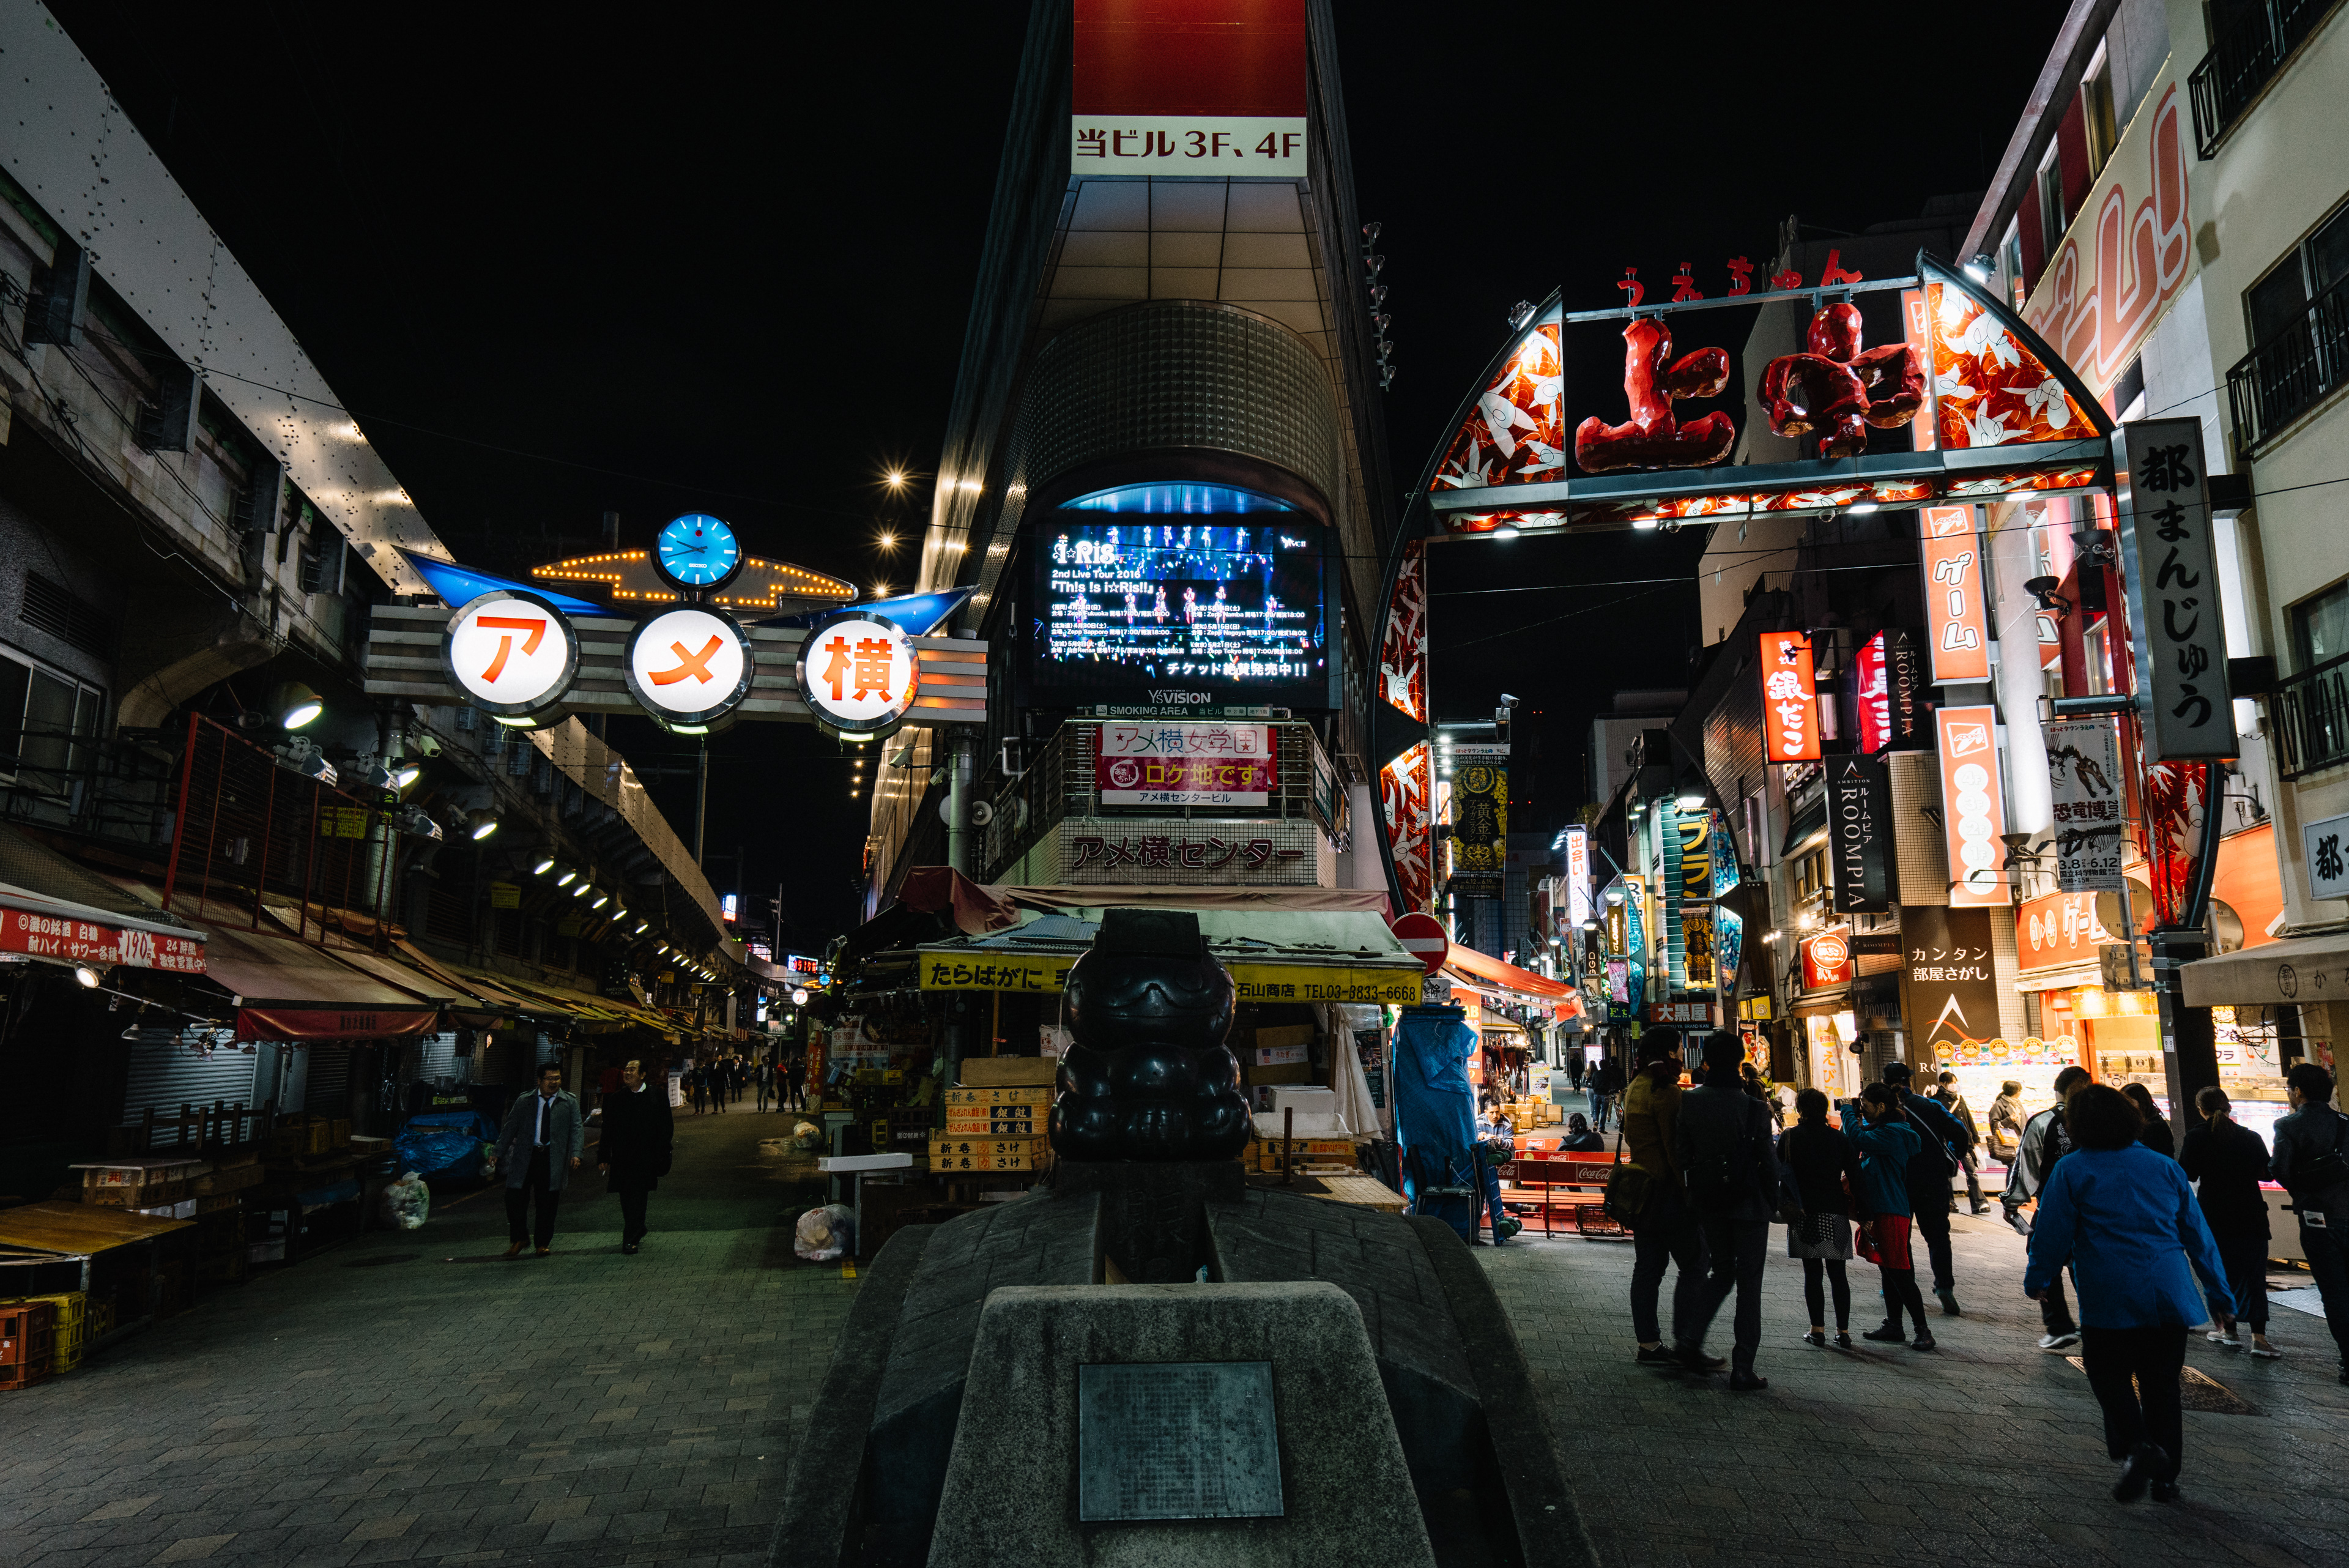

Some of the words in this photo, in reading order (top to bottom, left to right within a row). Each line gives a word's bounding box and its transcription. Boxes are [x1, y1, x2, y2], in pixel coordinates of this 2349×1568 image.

[1077, 128, 1175, 158] 当ビル
[1052, 570, 1070, 578] 2nd
[1072, 570, 1091, 578] Live
[1116, 570, 1141, 578] 2016
[2139, 444, 2211, 729] 都まんじゅう
[1934, 551, 1980, 652] ゲーム
[1163, 693, 1211, 704] VISION
[1896, 651, 1914, 735] ROOMPIA
[1110, 706, 1157, 716] SMOKING
[1160, 706, 1189, 715] AREA
[1766, 671, 1814, 756] 銀だこ
[1115, 727, 1258, 754] アメ横女学園
[1146, 763, 1258, 786] ロケ地です
[1962, 771, 1981, 786] 4F
[1139, 792, 1231, 803] アメ横センタービル
[1964, 796, 1984, 811] 3F
[1860, 787, 1872, 844] ルームピア
[1967, 821, 1986, 835] 2F
[1072, 836, 1305, 868] アメ横センター
[1841, 787, 1865, 907] ROOMPIA
[1970, 846, 1987, 860] 1F
[2059, 859, 2080, 869] 3.8
[1912, 947, 1987, 961] カンタン
[930, 963, 1042, 990] たらばがに
[1912, 967, 1989, 981] 部屋さがし
[1237, 983, 1295, 998] 石山商店
[1658, 1003, 1707, 1022] 大黒屋
[951, 1091, 976, 1103] 新巻
[995, 1106, 1027, 1118] 銀鮭
[996, 1121, 1027, 1133] 銀鮭
[941, 1143, 971, 1154] 新巻
[996, 1142, 1020, 1153] さけ
[942, 1157, 971, 1169] 新巻
[997, 1157, 1020, 1168] さけ
